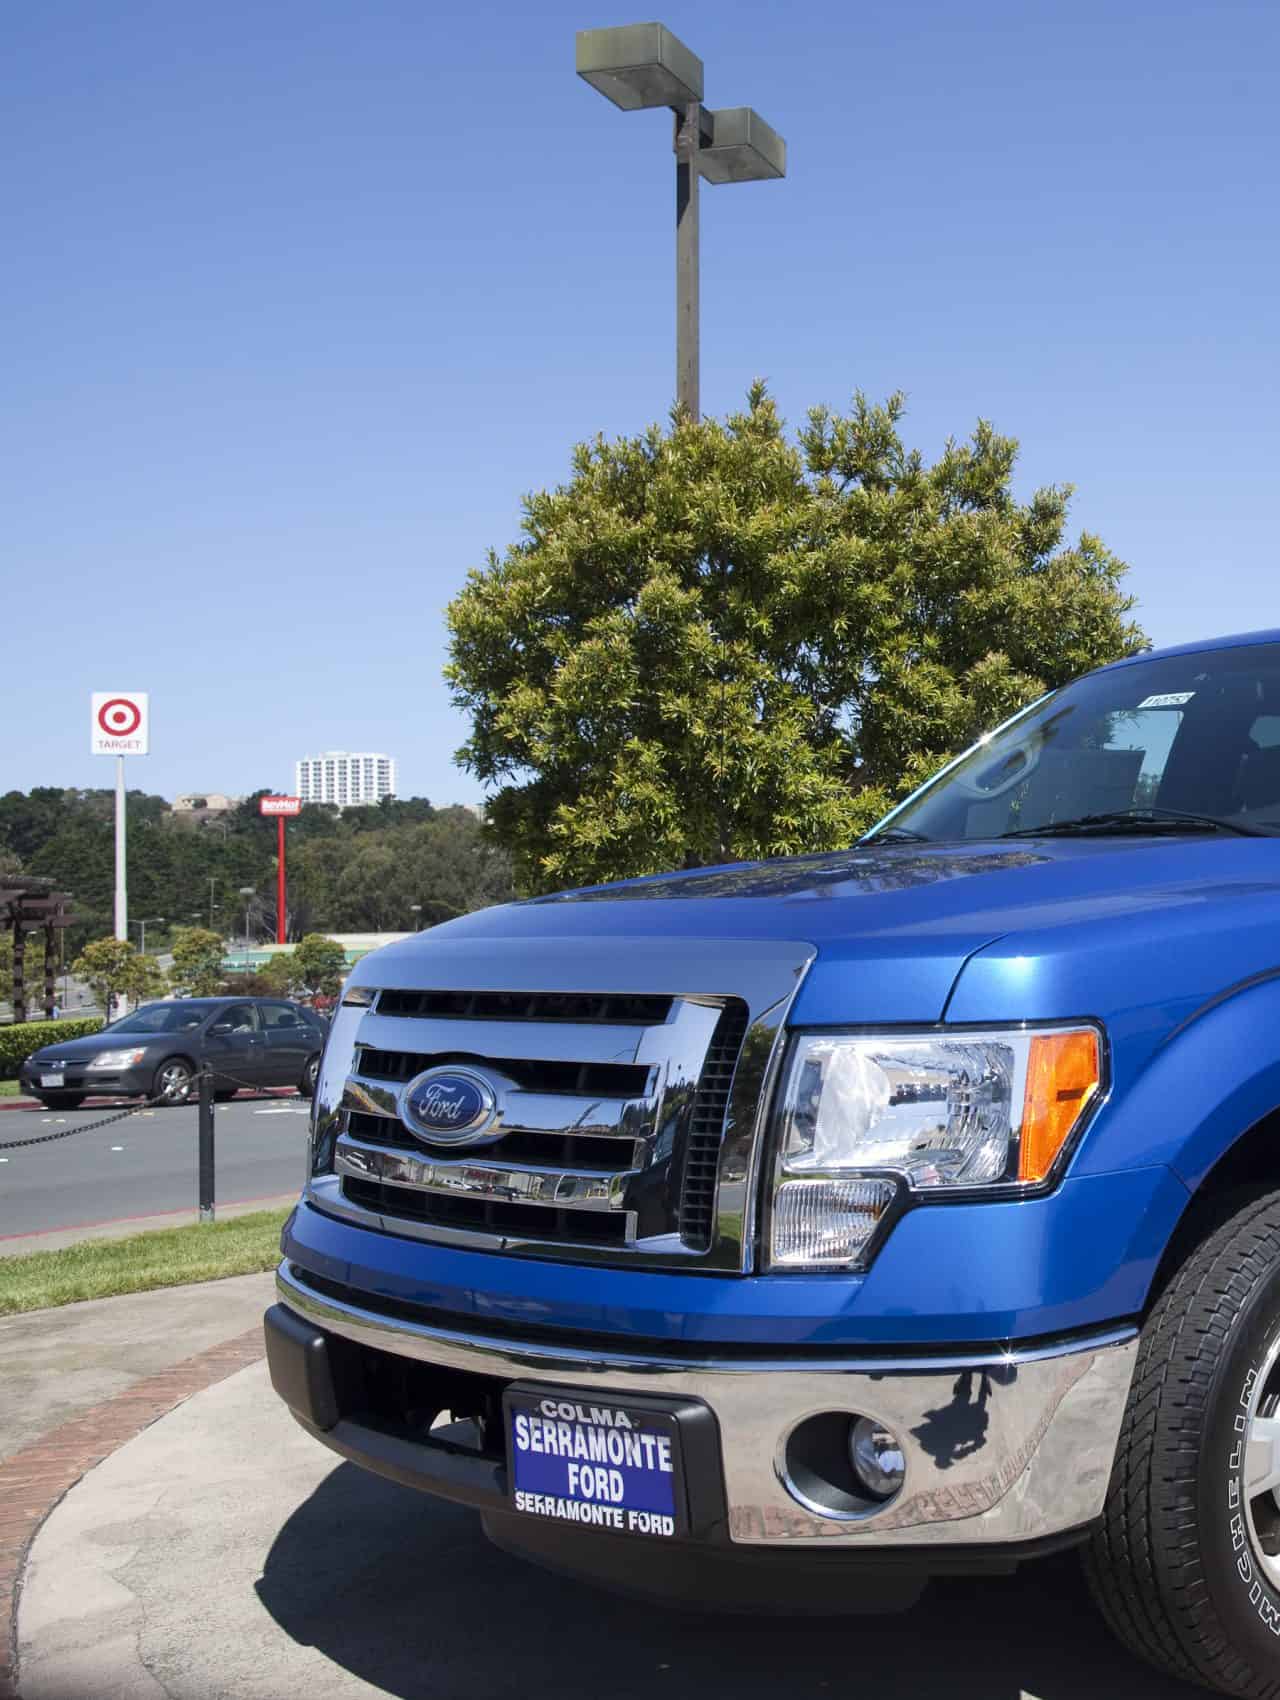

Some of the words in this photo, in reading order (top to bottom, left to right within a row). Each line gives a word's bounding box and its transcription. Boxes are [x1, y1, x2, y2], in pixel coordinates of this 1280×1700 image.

[98, 740, 141, 750] TARGET
[418, 1083, 467, 1120] Ford
[540, 1400, 633, 1428] COLMA
[515, 1414, 673, 1473] SERRAMONTE
[567, 1463, 625, 1503] FORD
[515, 1491, 624, 1529] SERRAMONTE
[629, 1511, 674, 1536] FORD
